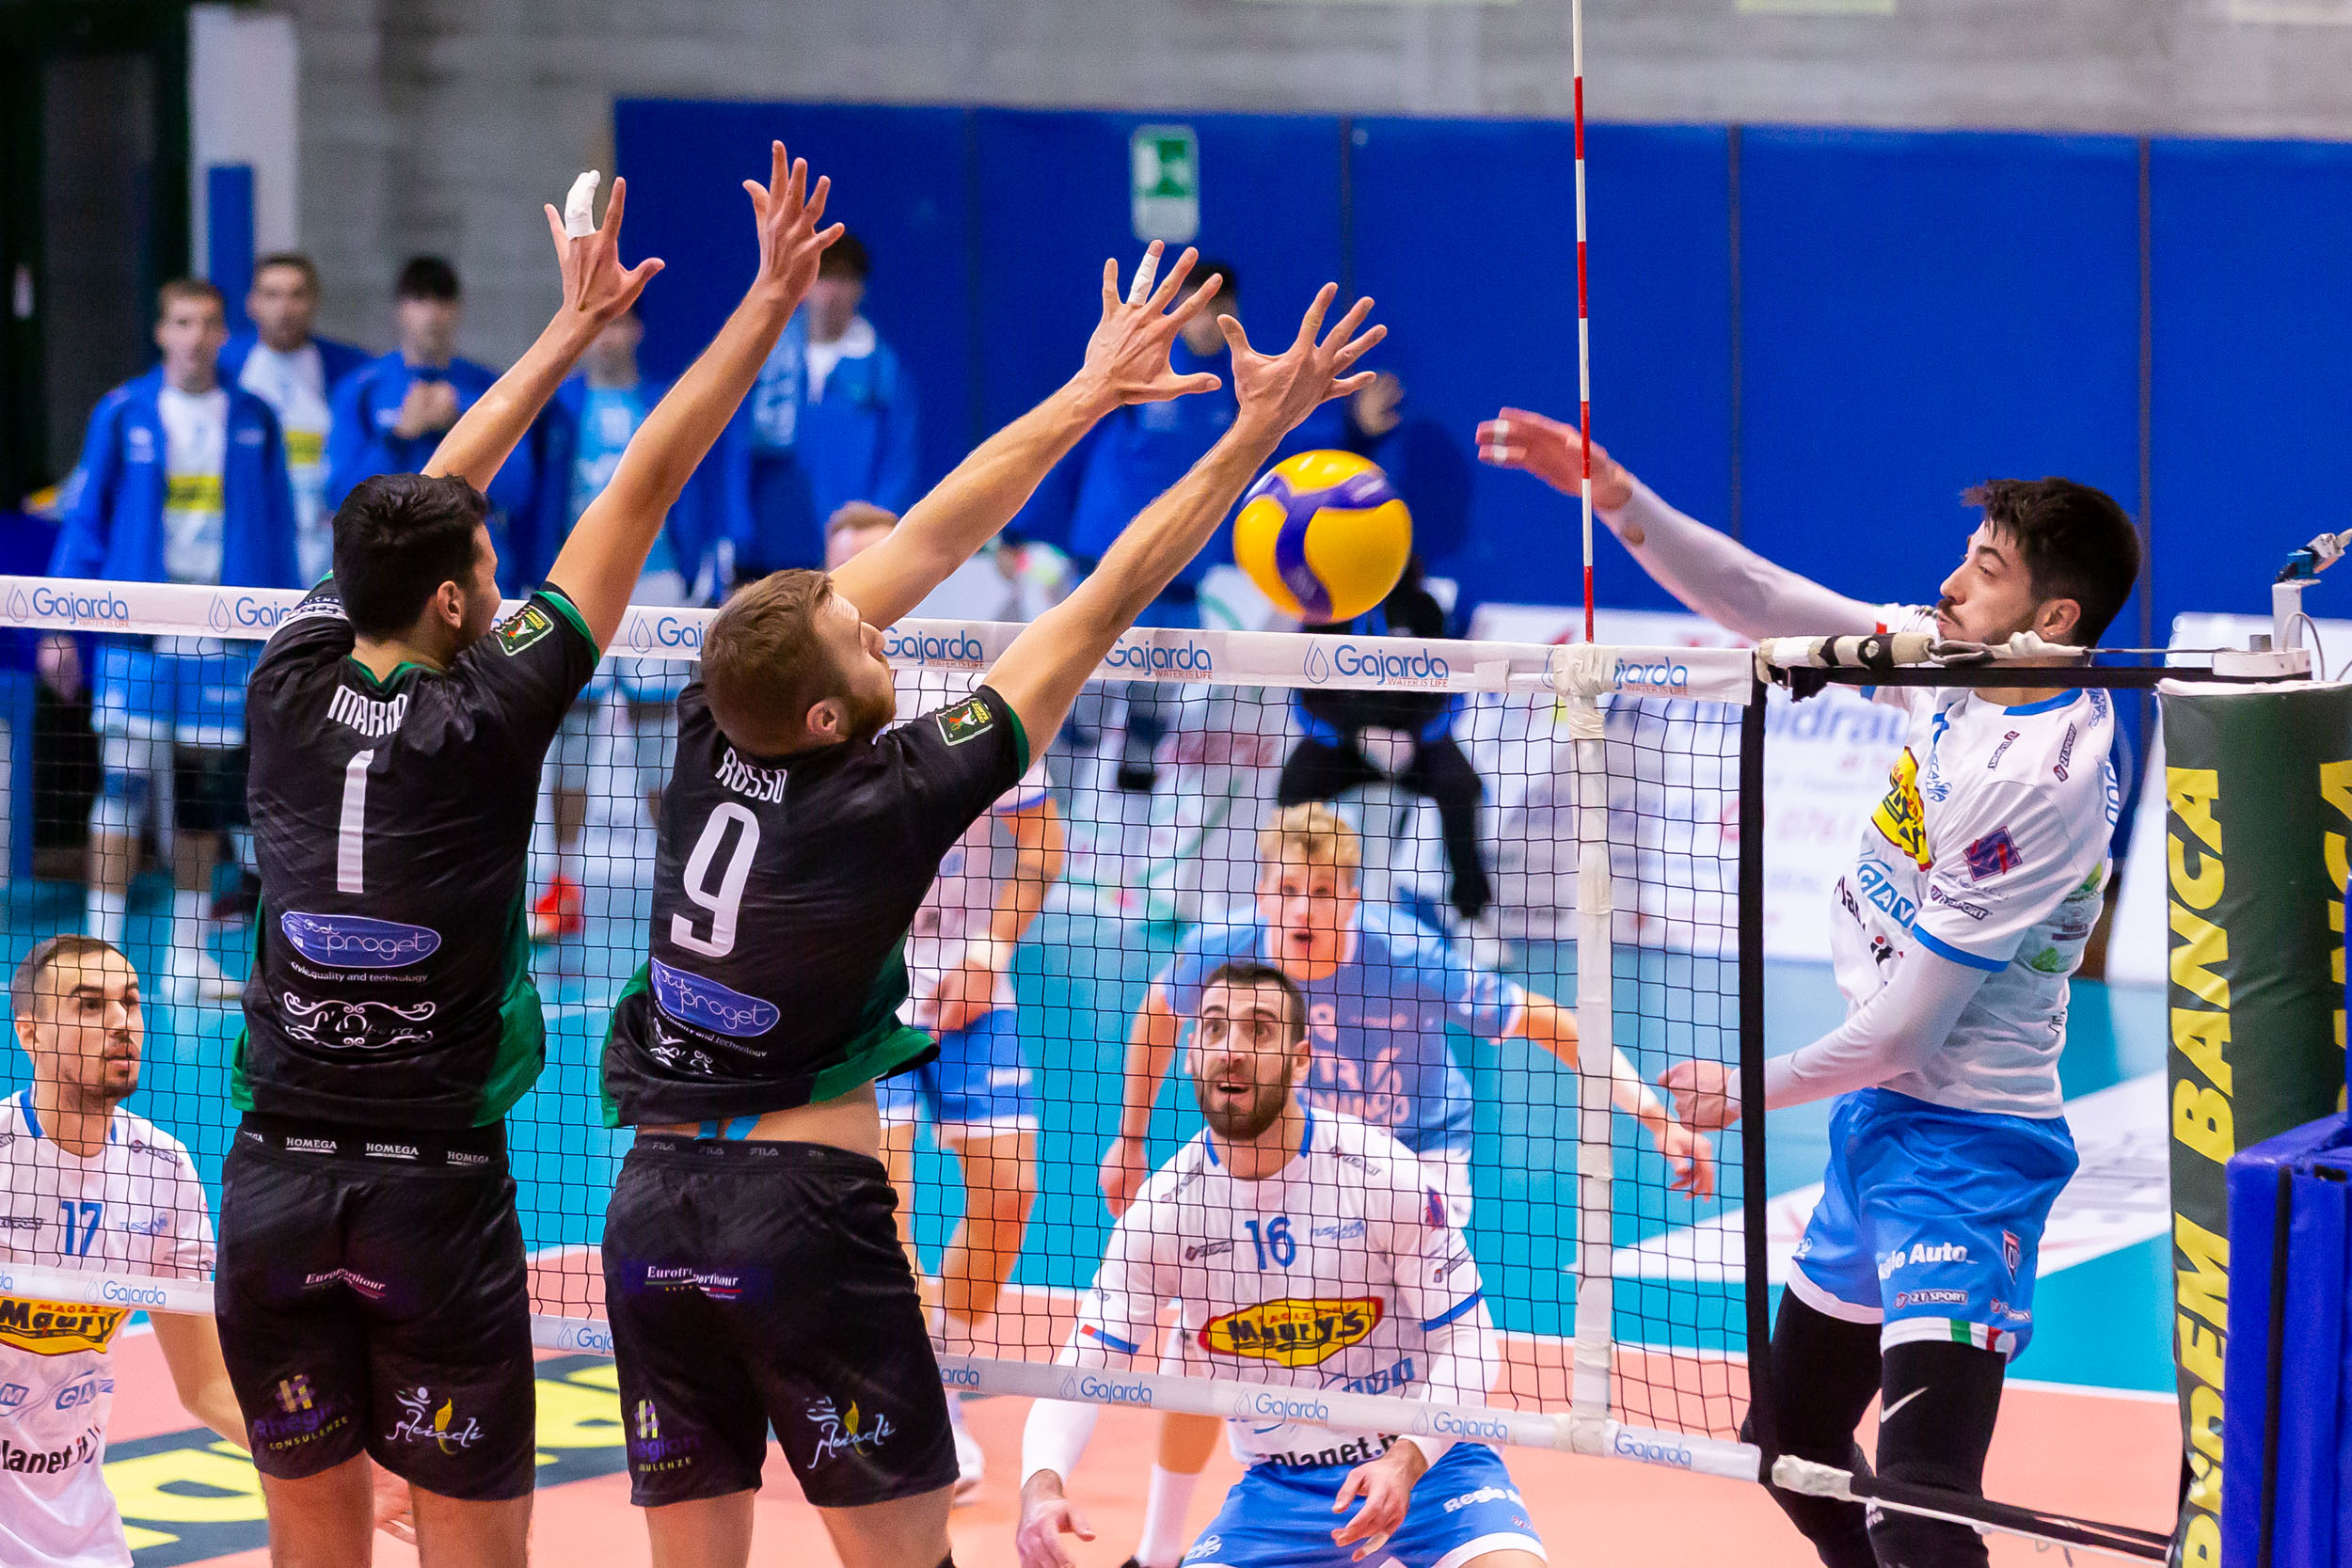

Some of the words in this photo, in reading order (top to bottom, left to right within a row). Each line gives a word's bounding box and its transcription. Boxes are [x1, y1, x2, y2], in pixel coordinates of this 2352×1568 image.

[33, 587, 129, 625] Gajarda
[882, 626, 984, 665] Gajarda
[1104, 638, 1213, 676] Gajarda
[1153, 669, 1184, 678] WATER
[1196, 671, 1213, 680] LIFE
[1334, 644, 1449, 686] Gajarda
[1387, 677, 1417, 688] WATER
[1429, 679, 1449, 688] LIFE
[715, 746, 788, 803] ROSSO
[337, 749, 374, 894] 1
[671, 801, 760, 958] 9
[326, 932, 433, 960] proget
[347, 973, 368, 982] and
[370, 973, 428, 983] technology
[2166, 767, 2235, 1166] BANCA
[679, 989, 771, 1030] proget
[286, 1136, 338, 1150] HOMEGA
[366, 1143, 420, 1156] HOMEGA
[652, 1141, 676, 1151] FILA
[699, 1145, 725, 1156] FILA
[749, 1147, 780, 1157] FILA
[61, 1200, 103, 1257] 17
[1245, 1215, 1296, 1271] 16
[1908, 1241, 1968, 1265] Auto
[103, 1280, 167, 1307] Gajarda
[1081, 1376, 1152, 1403] Gajarda
[1255, 1392, 1328, 1421] Gajarda
[268, 1416, 349, 1451] CONSULENZE
[1434, 1411, 1508, 1440] Gajarda
[1614, 1433, 1692, 1465] Gajarda
